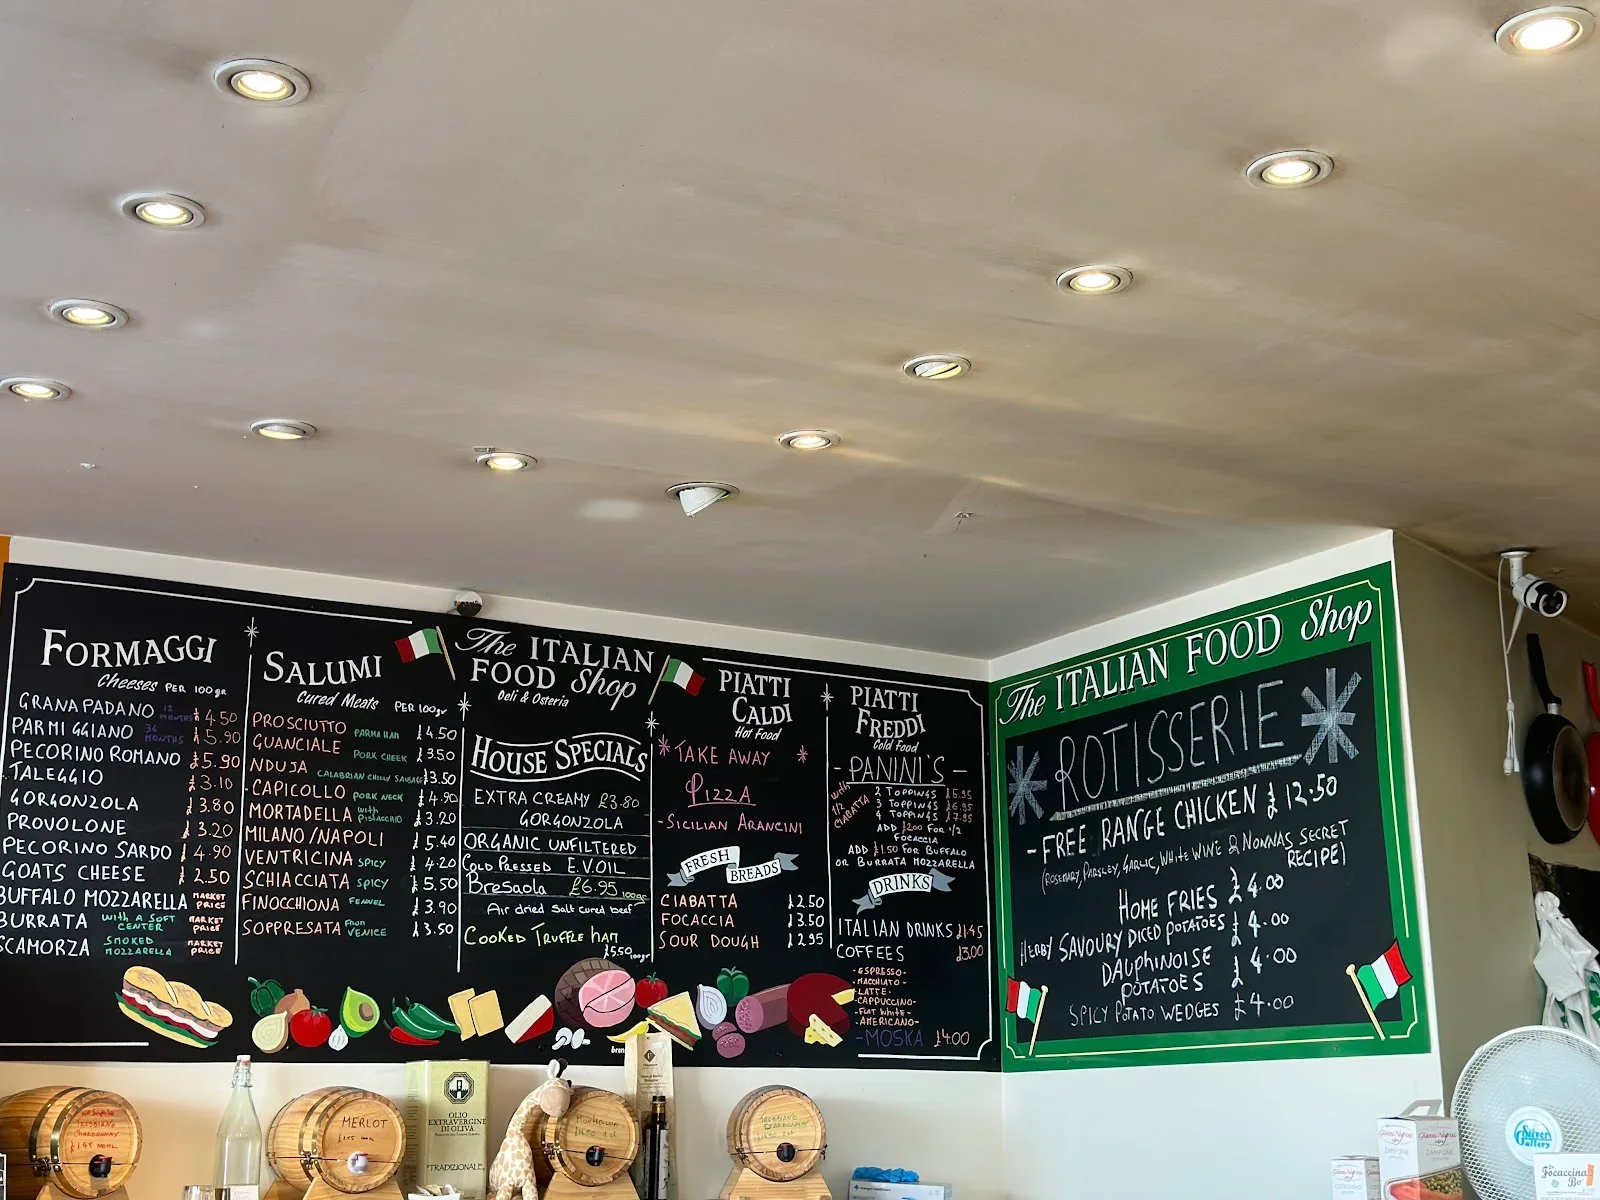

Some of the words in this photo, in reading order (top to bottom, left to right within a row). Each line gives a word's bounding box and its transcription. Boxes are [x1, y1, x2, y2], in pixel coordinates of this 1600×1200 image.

[40, 628, 217, 668] FORMAGGI
[455, 628, 517, 657] The
[530, 636, 654, 674] ITALIAN
[263, 651, 383, 686] SALUMI
[1000, 683, 1047, 724] The
[1055, 643, 1170, 712] ITALIAN
[1187, 613, 1282, 674] FOOD
[1301, 596, 1372, 643] Shop
[97, 673, 158, 692] Cheeses
[165, 683, 186, 693] PER
[470, 658, 556, 689] FOOD
[571, 668, 637, 711] Shop
[718, 669, 791, 698] PIATTI
[19, 692, 78, 712] GRANA
[82, 699, 155, 719] PADANO
[297, 691, 339, 706] Cured
[341, 693, 379, 710] Meats
[395, 701, 414, 713] PER
[497, 690, 518, 702] Deli
[520, 694, 529, 703] &
[532, 693, 569, 708] Osteria
[850, 685, 918, 712] PIATTI
[732, 697, 793, 725] CALDI
[252, 712, 347, 735] PROSCIUTTO
[855, 707, 926, 738] FREDDI
[354, 729, 381, 738] PARMA
[383, 731, 399, 740] HAM
[735, 726, 753, 738] Hot
[755, 728, 782, 741] Food
[10, 739, 104, 762] PECORINO
[110, 751, 181, 766] ROMANO
[253, 734, 341, 755] GUANCIALE
[675, 739, 718, 764] TAKE
[729, 748, 770, 766] AWAY
[873, 739, 894, 750] Cold
[896, 740, 919, 753] Food
[1055, 679, 1284, 811] ROTISSERIE
[354, 750, 378, 760] PORK
[381, 753, 407, 762] CHEEK
[471, 734, 548, 775] HOUSE
[554, 738, 648, 773] SPECIALS
[9, 760, 104, 785] TALEGGIO
[250, 758, 308, 774] NDUJA
[317, 769, 365, 780] CALABRIAN
[252, 779, 345, 799] CAPICOLLO
[353, 792, 378, 802] PORK
[381, 793, 404, 802] NECK
[475, 788, 527, 805] EXTRA
[533, 792, 590, 808] CREAMY
[598, 793, 640, 809] £3.80
[685, 773, 751, 805] PIZZA
[886, 787, 936, 799] TOPPINGS
[10, 788, 139, 811] GORGONZOLA
[889, 799, 938, 810] TOPPINGS
[249, 802, 352, 822] MORTADELLA
[520, 810, 623, 830] GORGONZOLA
[890, 810, 938, 821] TOPPINGS
[1102, 809, 1166, 852] RANGE
[1175, 784, 1257, 831] CHICKEN
[7, 812, 127, 836] PROVOLONE
[738, 813, 802, 834] ARANCINI
[877, 824, 897, 832] ADD
[927, 824, 945, 833] FOR
[245, 826, 305, 844] MILANO
[464, 833, 541, 851] ORGANIC
[549, 837, 637, 855] UNFILTERED
[894, 835, 938, 844] FOCACCIA
[1243, 830, 1293, 852] NONNAS
[1299, 819, 1348, 845] SECRET
[3, 836, 108, 855] PECORINO
[114, 841, 172, 860] SARDO
[848, 845, 868, 855] ADD
[902, 844, 919, 854] FOR
[926, 846, 967, 856] BUFFALO
[245, 849, 353, 866] VENTRICINA
[358, 858, 386, 868] SPICY
[462, 854, 493, 872] COLD
[499, 855, 551, 872] PRESSED
[684, 850, 730, 873] FRESH
[730, 862, 779, 882] BREADS
[858, 856, 906, 867] BURRATA
[914, 857, 975, 869] MOZZARELLA
[2, 860, 65, 882] GOATS
[78, 865, 146, 882] CHEESE
[243, 870, 350, 889] SCHIACCIATA
[357, 879, 389, 889] SPICY
[569, 877, 617, 896] £6.95
[873, 875, 930, 894] DRINKS
[84, 889, 188, 910] MOZZARELLA
[242, 894, 340, 912] FINOCCHIONA
[349, 898, 385, 906] FENNEL
[487, 903, 508, 915] Air
[515, 904, 544, 914] dried
[660, 893, 738, 908] CIABATTA
[1119, 888, 1159, 926] HOME
[1167, 884, 1218, 916] FRIES
[117, 923, 163, 931] CENTER
[150, 913, 175, 924] SOFT
[189, 916, 224, 924] MARKET
[242, 920, 341, 936] SOPPRESATA
[662, 913, 734, 928] FOCACCIA
[839, 918, 899, 937] ITALIAN
[907, 922, 953, 938] DRINKS
[104, 937, 153, 945] SMOKED
[348, 928, 387, 937] VENICE
[464, 925, 526, 945] COOKED
[531, 922, 584, 947] TRUFFLE
[659, 931, 698, 949] SOUR
[711, 934, 759, 950] DOUGH
[1059, 929, 1122, 962] SAVOURY
[1128, 926, 1161, 953] DICED
[1166, 913, 1225, 945] POTATOES
[105, 947, 172, 956] MOZZARELLA
[837, 944, 904, 962] COFFEES
[1122, 972, 1204, 1005] POTATOES
[1069, 1004, 1108, 1027] SPICY
[1161, 1002, 1220, 1021] WEDGES
[342, 1116, 388, 1128] MERLOT
[1523, 1125, 1549, 1137] Silver
[1514, 1131, 1550, 1149] Gallery
[1542, 1166, 1587, 1178] Focaccina
